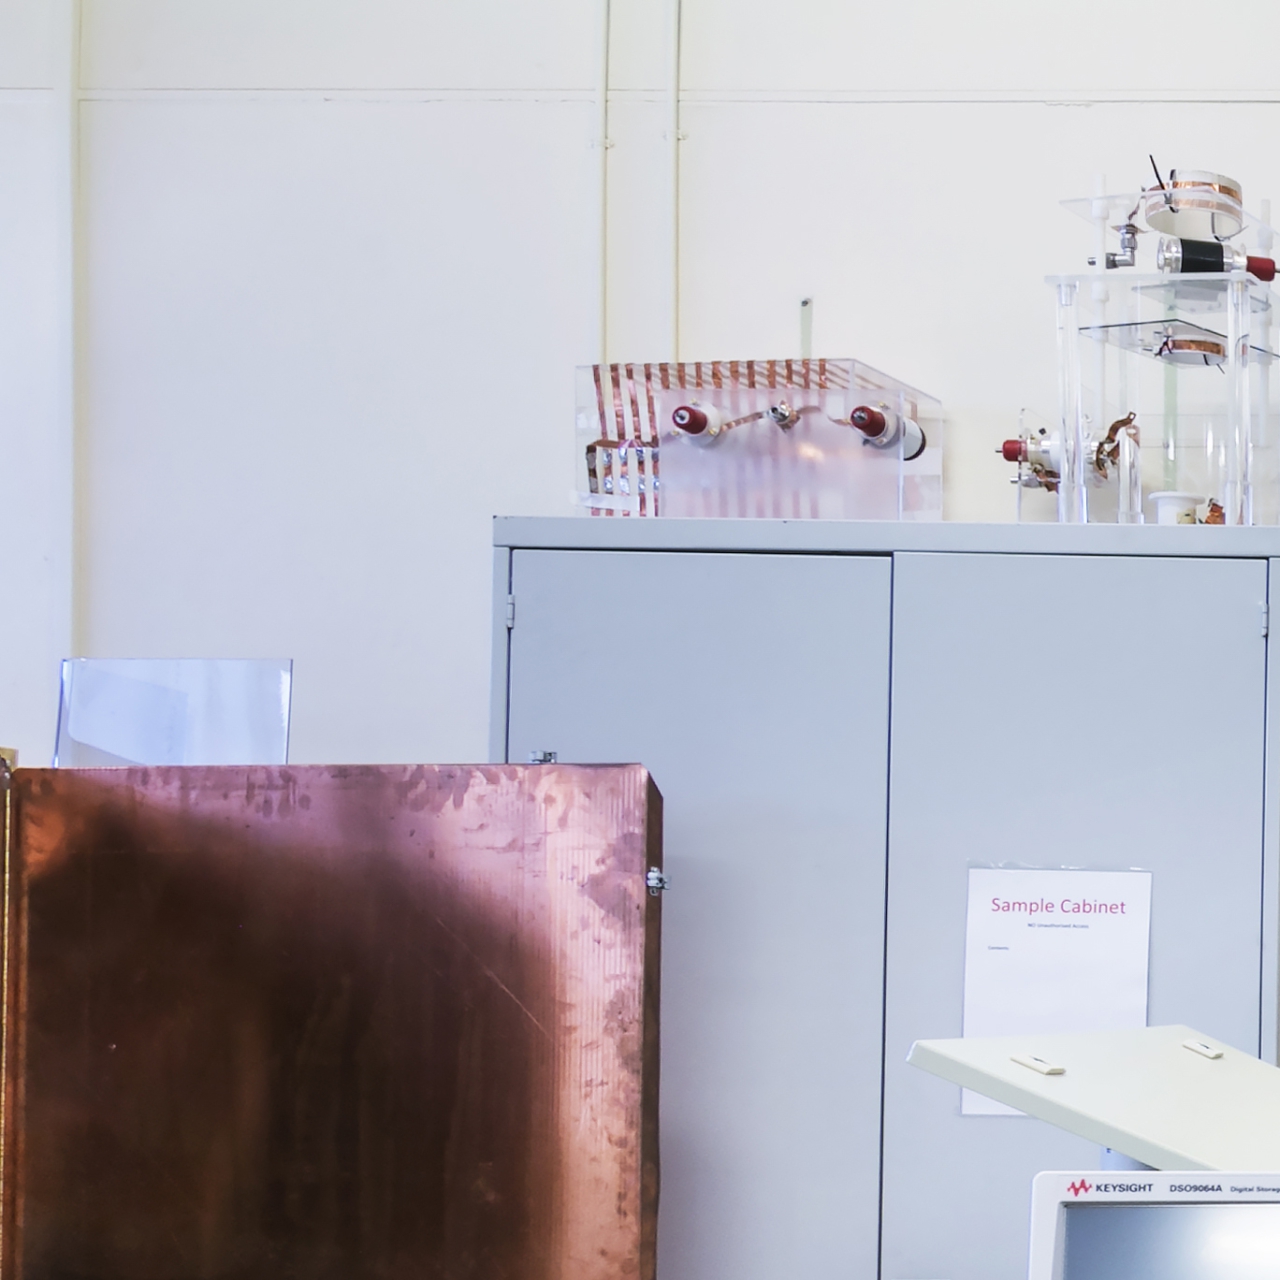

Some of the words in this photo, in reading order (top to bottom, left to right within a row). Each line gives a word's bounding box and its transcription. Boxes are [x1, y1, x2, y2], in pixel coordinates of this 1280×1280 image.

[991, 897, 1055, 915] Sample
[1060, 899, 1126, 914] Cabinet
[1095, 1183, 1154, 1193] KEYSIGHT
[1169, 1183, 1223, 1193] DSO9064A
[1230, 1185, 1254, 1193] Digital
